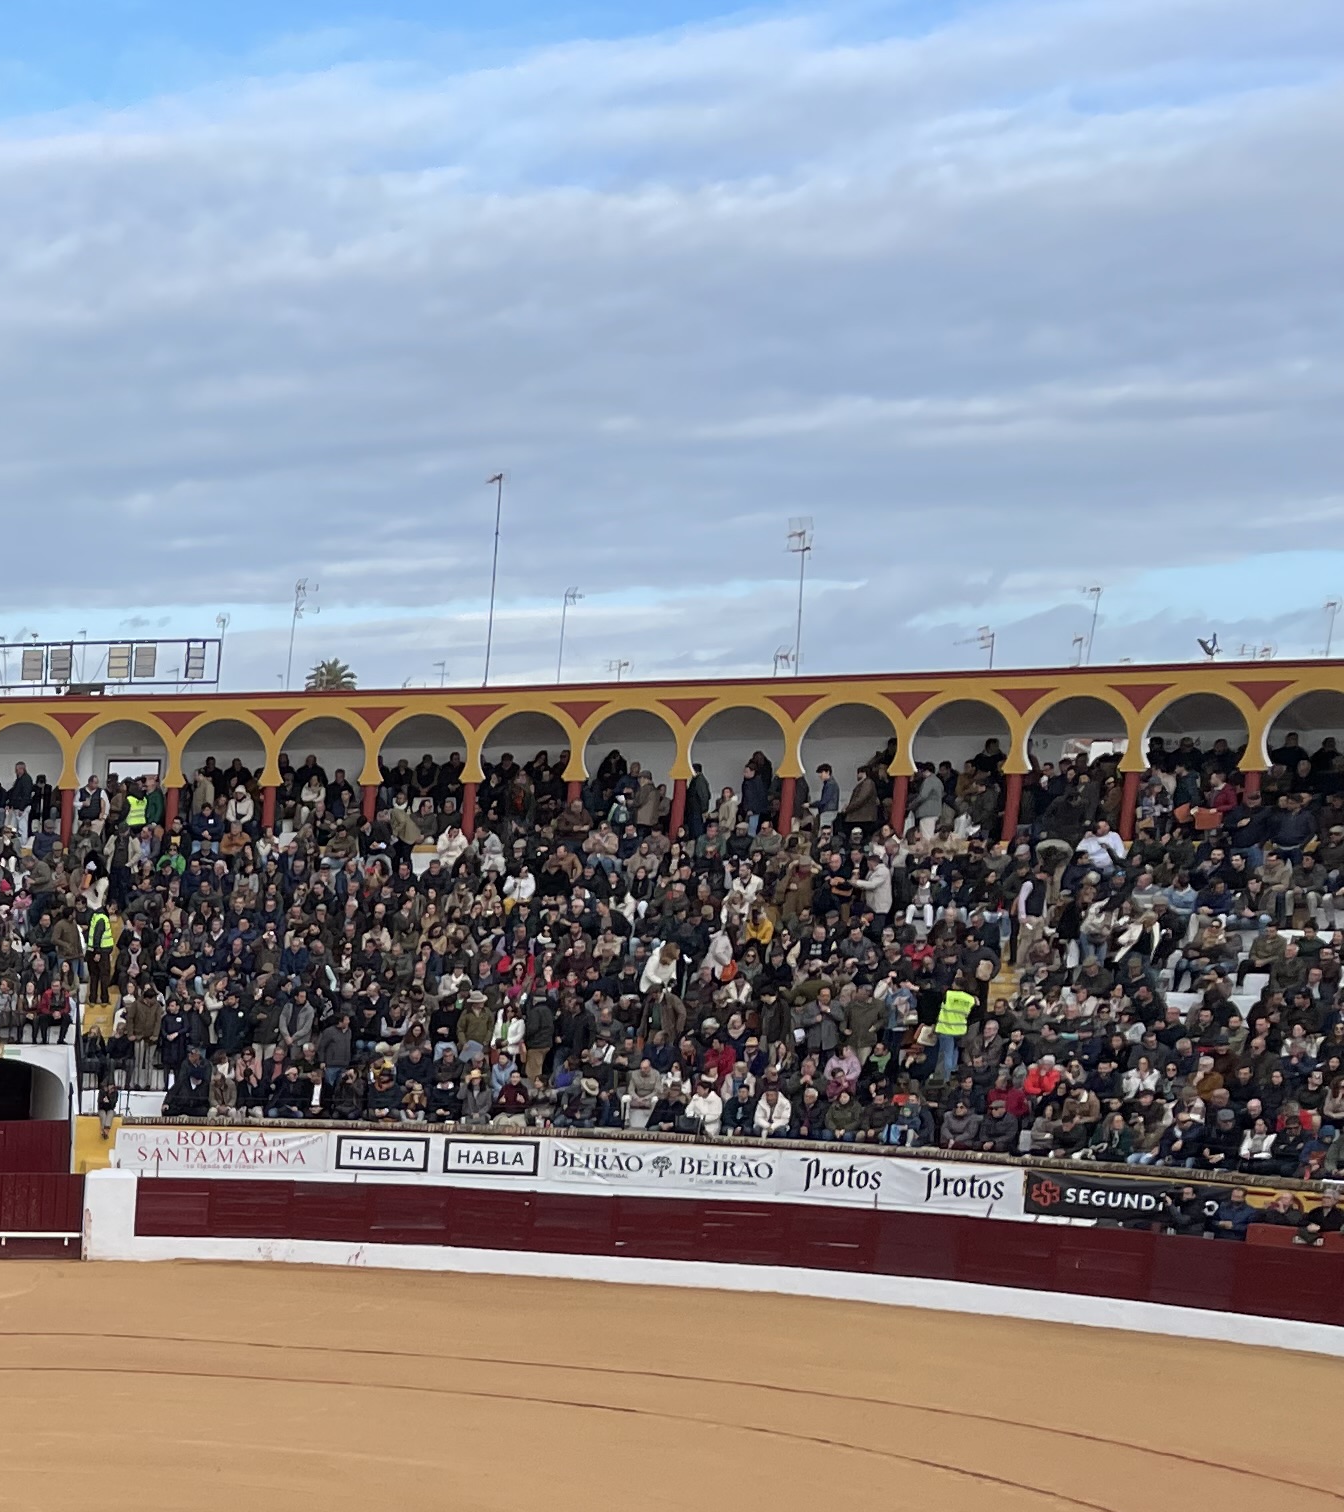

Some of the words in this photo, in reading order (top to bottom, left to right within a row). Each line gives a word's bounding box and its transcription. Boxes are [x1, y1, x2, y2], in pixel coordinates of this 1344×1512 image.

[176, 1131, 268, 1147] BODEGA
[137, 1146, 208, 1162] SANTA
[216, 1147, 307, 1165] MARINA
[349, 1146, 416, 1163] HABLA
[457, 1149, 525, 1166] HABLA
[800, 1157, 883, 1193] Protos
[921, 1166, 1005, 1202] Protos
